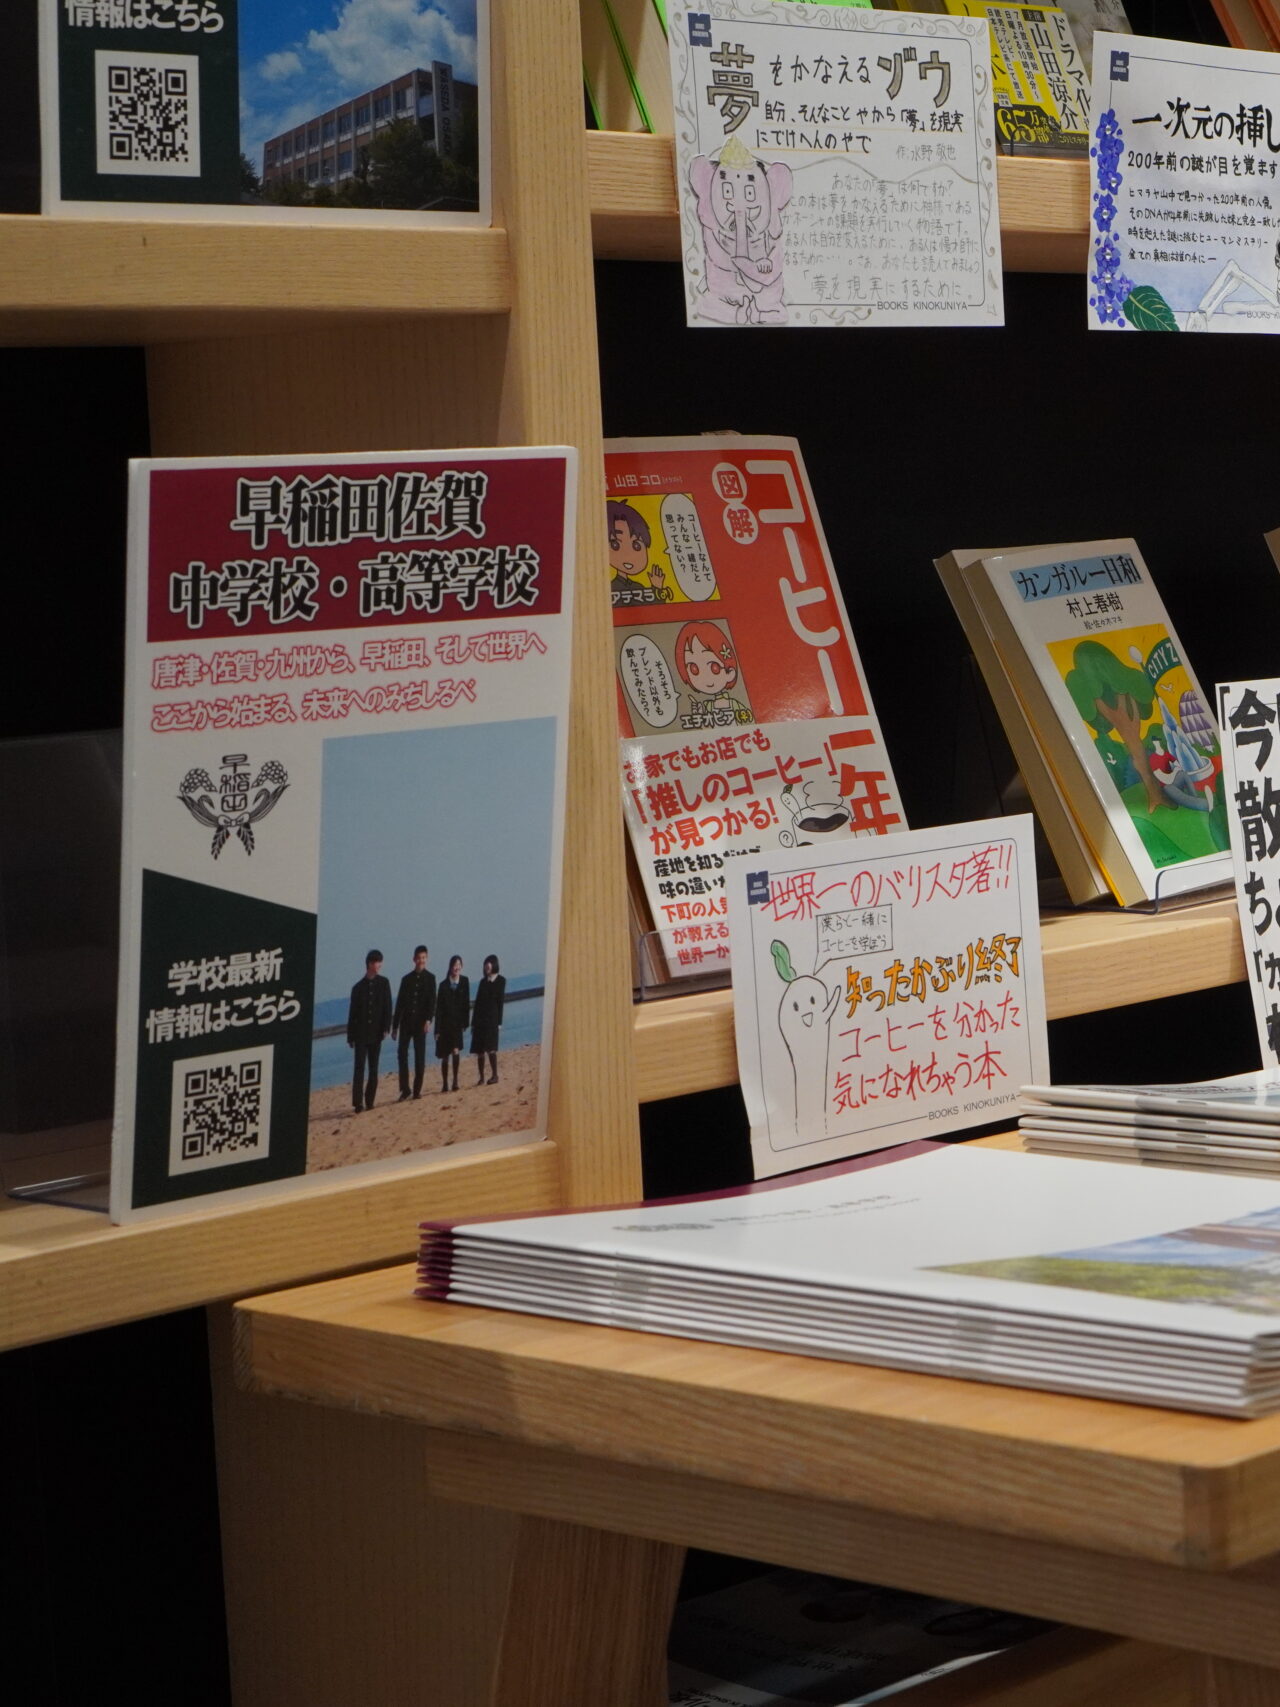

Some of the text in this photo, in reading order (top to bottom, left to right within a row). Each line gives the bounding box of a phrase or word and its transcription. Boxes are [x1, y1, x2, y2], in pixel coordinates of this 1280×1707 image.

[63, 0, 225, 34] 情報はこちら
[706, 41, 951, 135] 夢をかなえるゾウ
[1029, 22, 1079, 131] 山田涼介
[1127, 150, 1278, 179] 200年前の謎が目を覚ます
[877, 301, 968, 311] BOOKS KINOKUNIYA
[231, 470, 487, 550] 早稲田佐賀
[716, 469, 756, 540] 図解
[665, 514, 688, 573] 思ってない?
[676, 513, 702, 583] みんな一緒だと
[687, 513, 712, 582] コーヒーなんて
[169, 544, 540, 630] 中学校・高等学校
[1016, 553, 1142, 600] カンガルー日和
[1065, 591, 1125, 619] 村上春樹
[625, 647, 651, 717] 飲んでみたら?
[654, 660, 672, 700] そろそろ
[1148, 646, 1169, 679] CITY
[150, 678, 478, 733] ここから始まる、未来へのみちしるべ
[623, 728, 771, 784] お家でもお店でも
[631, 741, 838, 824] 「推しのコーヒー」
[649, 797, 780, 856] が見つかる!
[761, 843, 1015, 923] 世界一のバリスタ著!!
[821, 912, 888, 934] 僕らと一緒に
[821, 935, 888, 954] コーヒーを学ぼう
[167, 947, 284, 997] 学校最新
[146, 989, 302, 1044] 情報はこちら
[838, 989, 1022, 1063] コーヒーを分かった
[833, 1040, 1008, 1115] 気になれちゃう本
[928, 1092, 1017, 1121] BOOKS KINOKUNIYA
